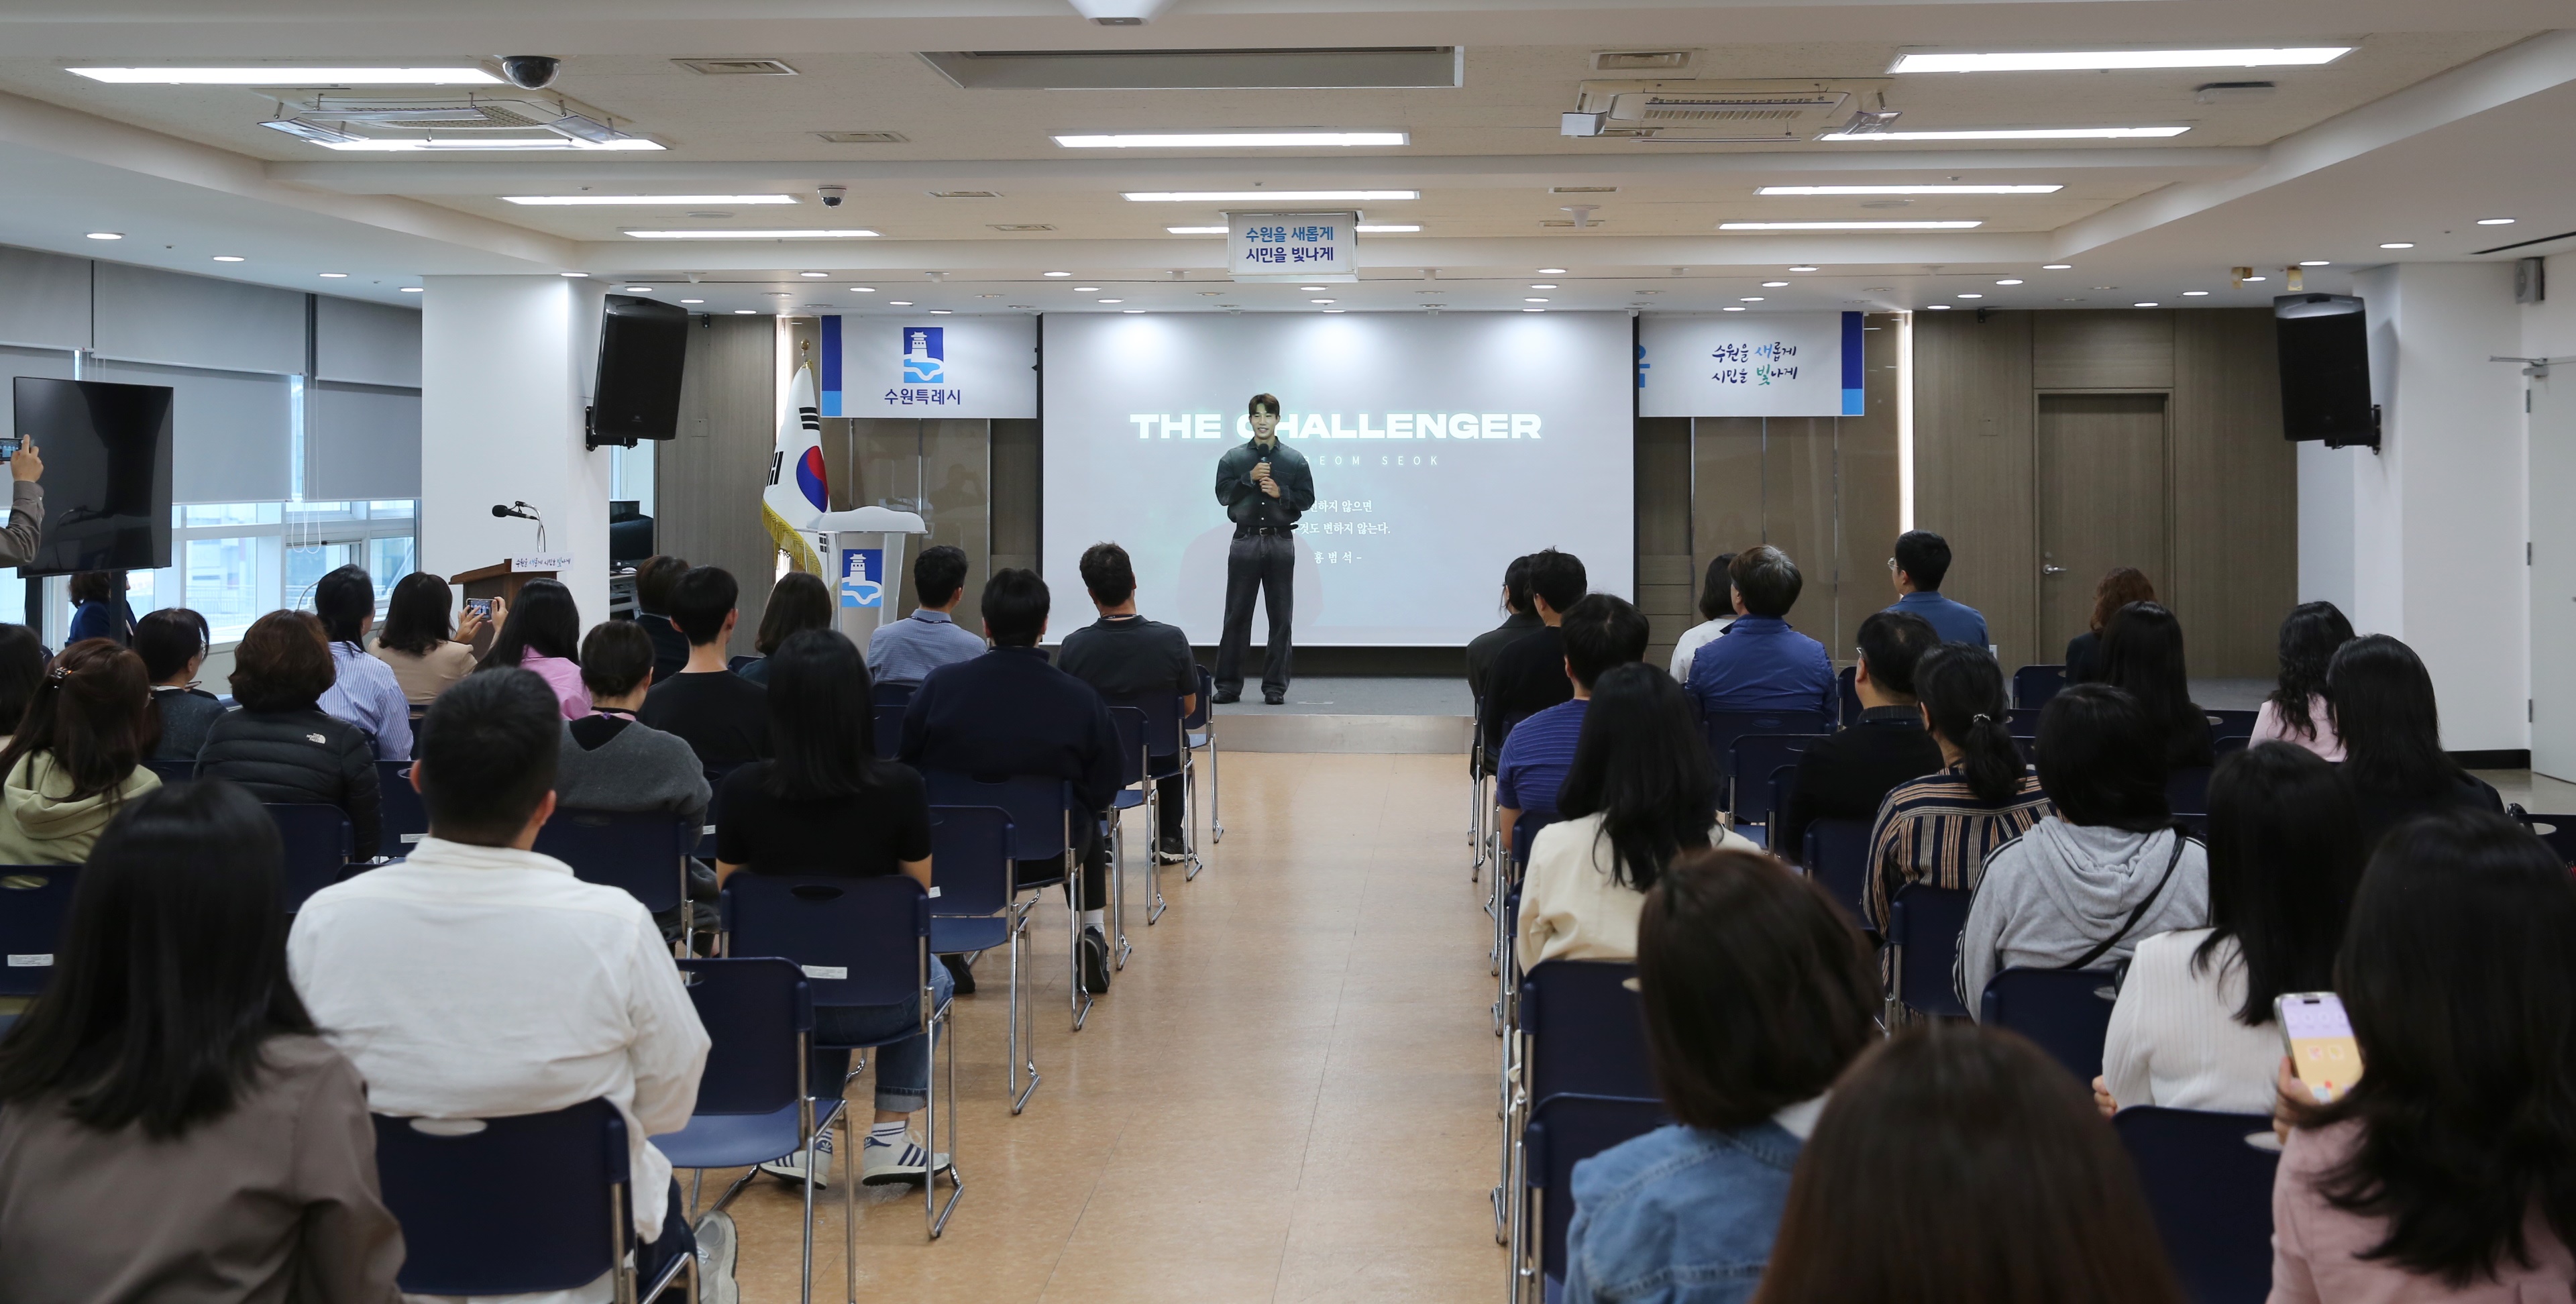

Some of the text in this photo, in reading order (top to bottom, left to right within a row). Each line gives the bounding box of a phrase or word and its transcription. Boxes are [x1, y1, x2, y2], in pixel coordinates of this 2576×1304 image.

[1246, 226, 1333, 243] 수원을 새롭게
[1246, 247, 1334, 263] 시민을 빛나게
[1712, 341, 1796, 363] 수원을 새롭게
[1711, 364, 1798, 386] 시민을 빛나게
[884, 388, 961, 405] 수원특례시
[1130, 414, 1221, 439] THE
[1382, 455, 1438, 466] SEOK
[1342, 500, 1373, 512] 않으면
[1324, 522, 1353, 535] 변하지
[1357, 522, 1391, 535] 않는다.
